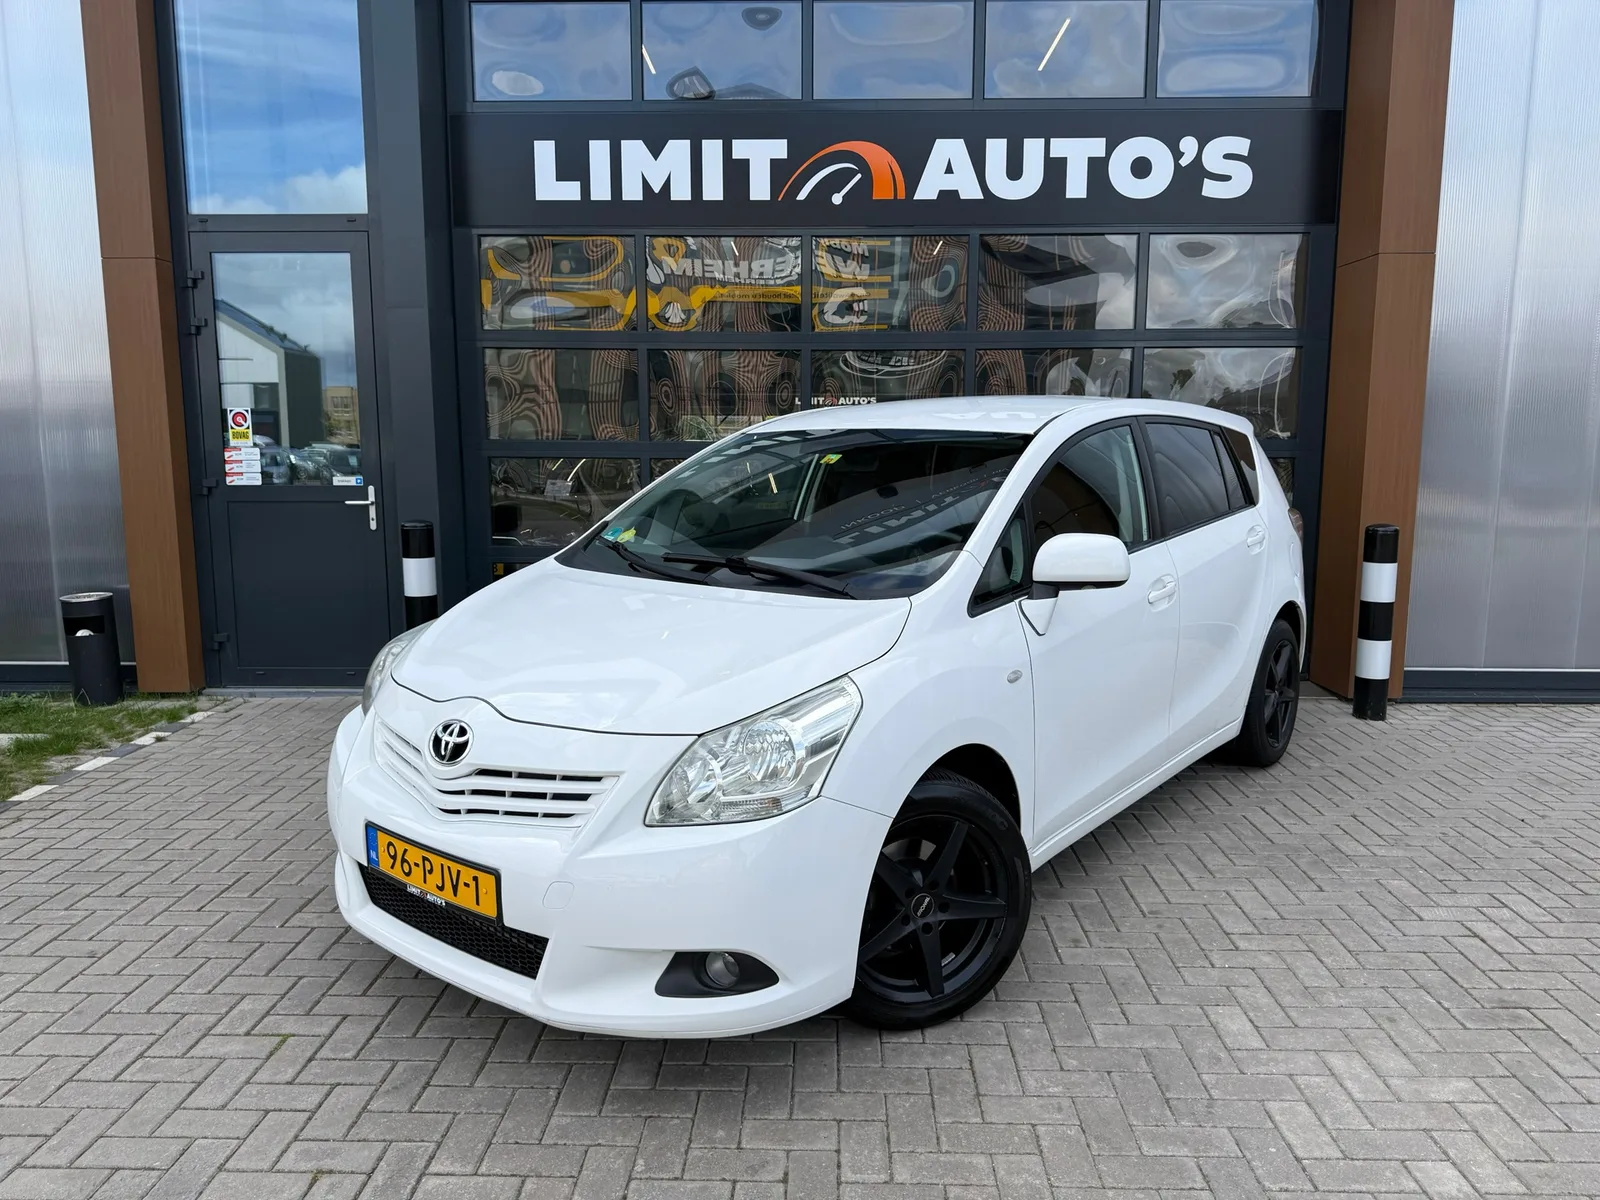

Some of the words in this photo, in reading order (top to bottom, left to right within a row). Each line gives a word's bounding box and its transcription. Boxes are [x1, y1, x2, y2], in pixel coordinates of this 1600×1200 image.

[534, 139, 788, 200] LIMIT
[913, 136, 1252, 199] AUTO'S
[232, 431, 250, 439] BOVAG
[370, 850, 378, 861] NL
[386, 840, 480, 906] 96-PJV-1
